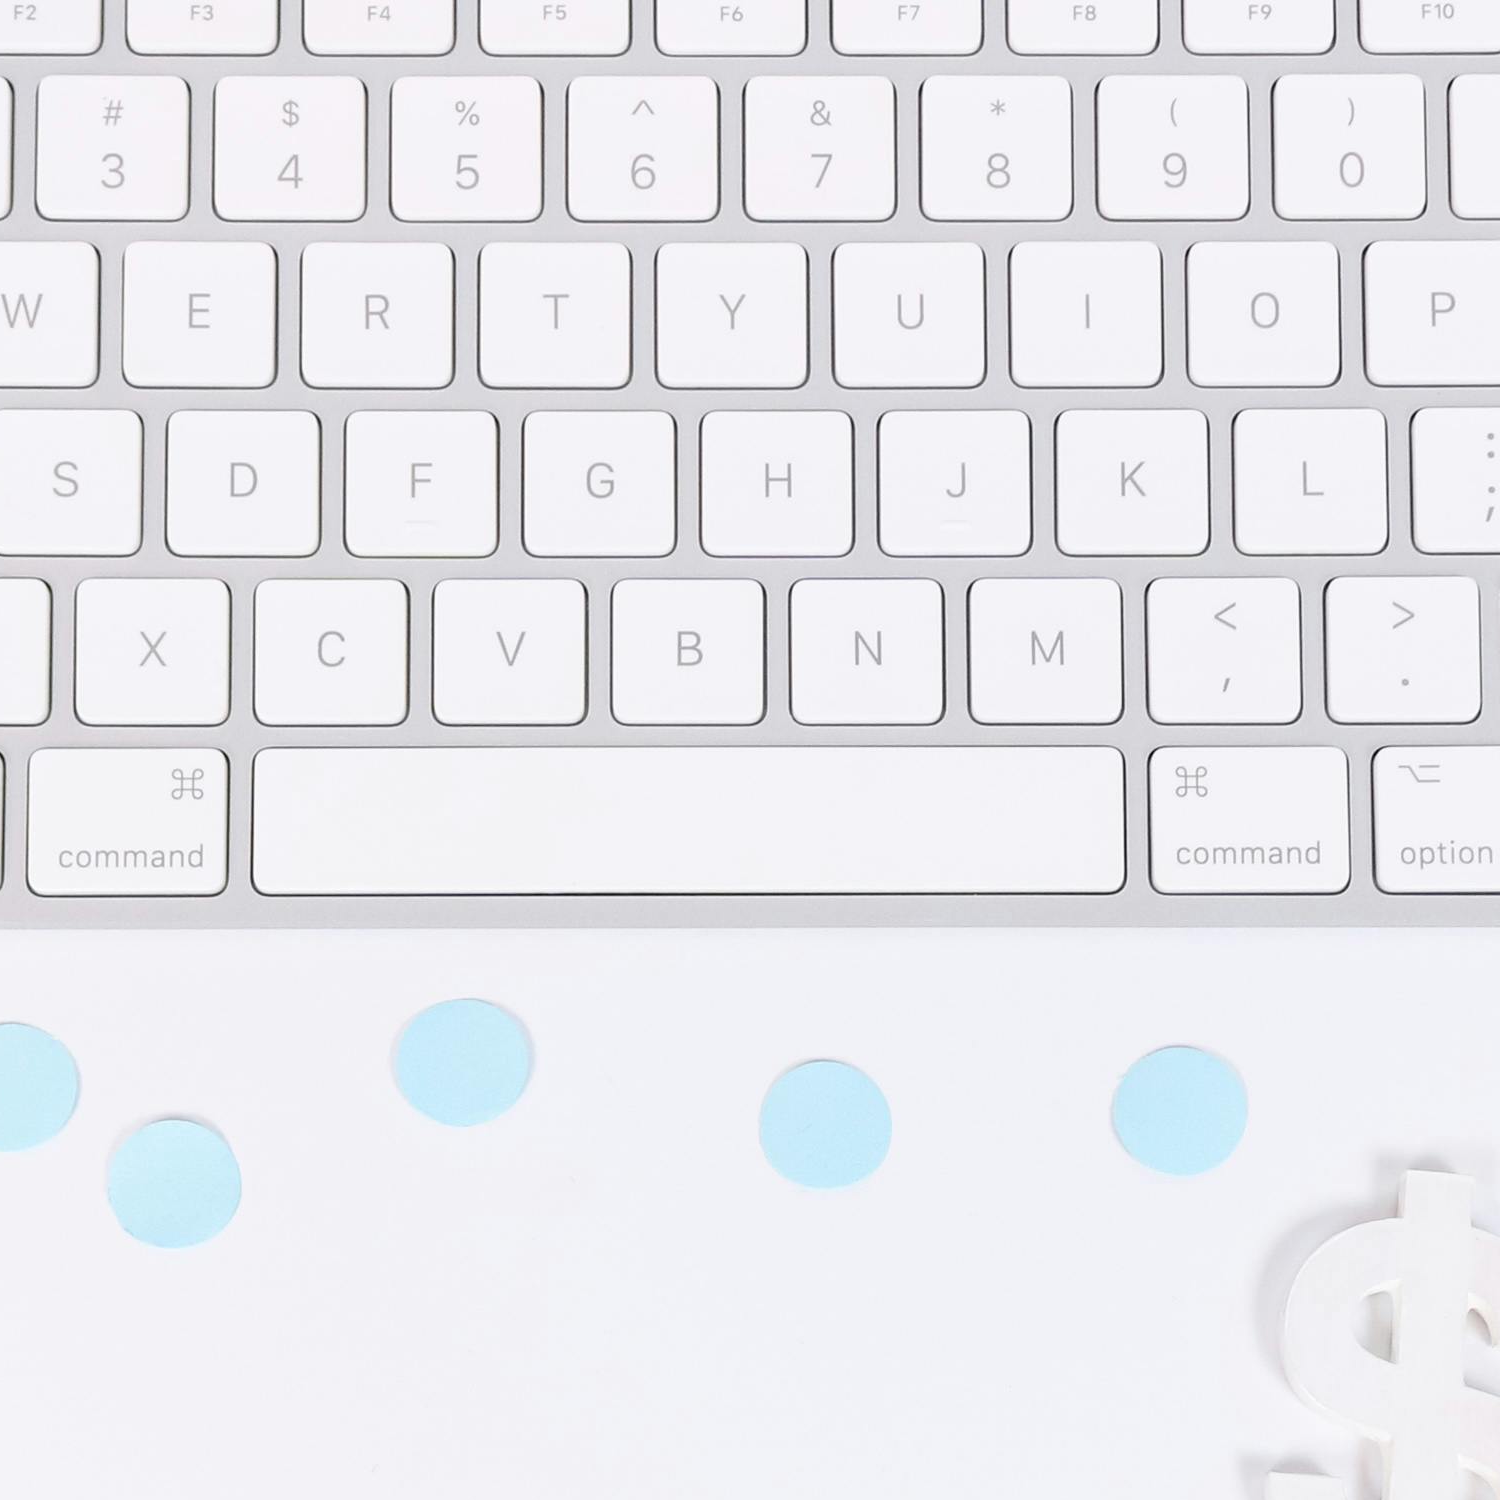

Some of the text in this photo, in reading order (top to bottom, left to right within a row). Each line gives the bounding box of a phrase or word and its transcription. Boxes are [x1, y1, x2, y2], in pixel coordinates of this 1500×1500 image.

[13, 3, 37, 21] F2
[190, 4, 215, 22] F3
[367, 5, 392, 22] F4
[542, 4, 568, 21] F5
[719, 5, 744, 23] F6
[897, 4, 921, 21] F7
[1072, 4, 1097, 22] F8
[1248, 3, 1273, 21] F9
[1421, 2, 1455, 20] F10
[102, 99, 124, 126] #
[281, 99, 300, 128] $
[454, 100, 481, 127] %
[631, 99, 655, 116] ^
[809, 99, 832, 127] &
[1169, 97, 1178, 128] (
[1347, 97, 1356, 127] )
[100, 152, 126, 190] 3
[277, 153, 304, 189] 4
[455, 153, 480, 191] 5
[630, 153, 657, 191] 6
[810, 153, 833, 189] 7
[985, 152, 1011, 190] 8
[1162, 152, 1188, 189] 9
[1339, 151, 1365, 189] 0
[0, 293, 44, 329] W
[188, 292, 211, 329] E
[364, 293, 390, 330] R
[542, 293, 570, 330] T
[719, 293, 746, 331] Y
[896, 293, 925, 331] U
[1084, 293, 1091, 330] I
[1250, 291, 1280, 330] O
[1430, 291, 1456, 328] P
[1486, 432, 1496, 459] :
[52, 460, 79, 498] S
[229, 461, 259, 498] D
[410, 462, 433, 499] F
[585, 461, 615, 500] G
[764, 462, 793, 498] H
[945, 461, 967, 499] J
[1120, 461, 1147, 497] K
[1302, 460, 1325, 497] L
[1485, 485, 1496, 523] ;
[1213, 602, 1237, 631] <
[1392, 601, 1416, 630] >
[139, 630, 167, 667] X
[317, 630, 346, 668] C
[495, 630, 526, 667] V
[676, 630, 704, 667] B
[854, 630, 883, 666] N
[1030, 630, 1065, 666] M
[1400, 678, 1410, 687] .
[58, 843, 204, 869] command
[1176, 840, 1321, 866] command
[1400, 842, 1494, 870] option
